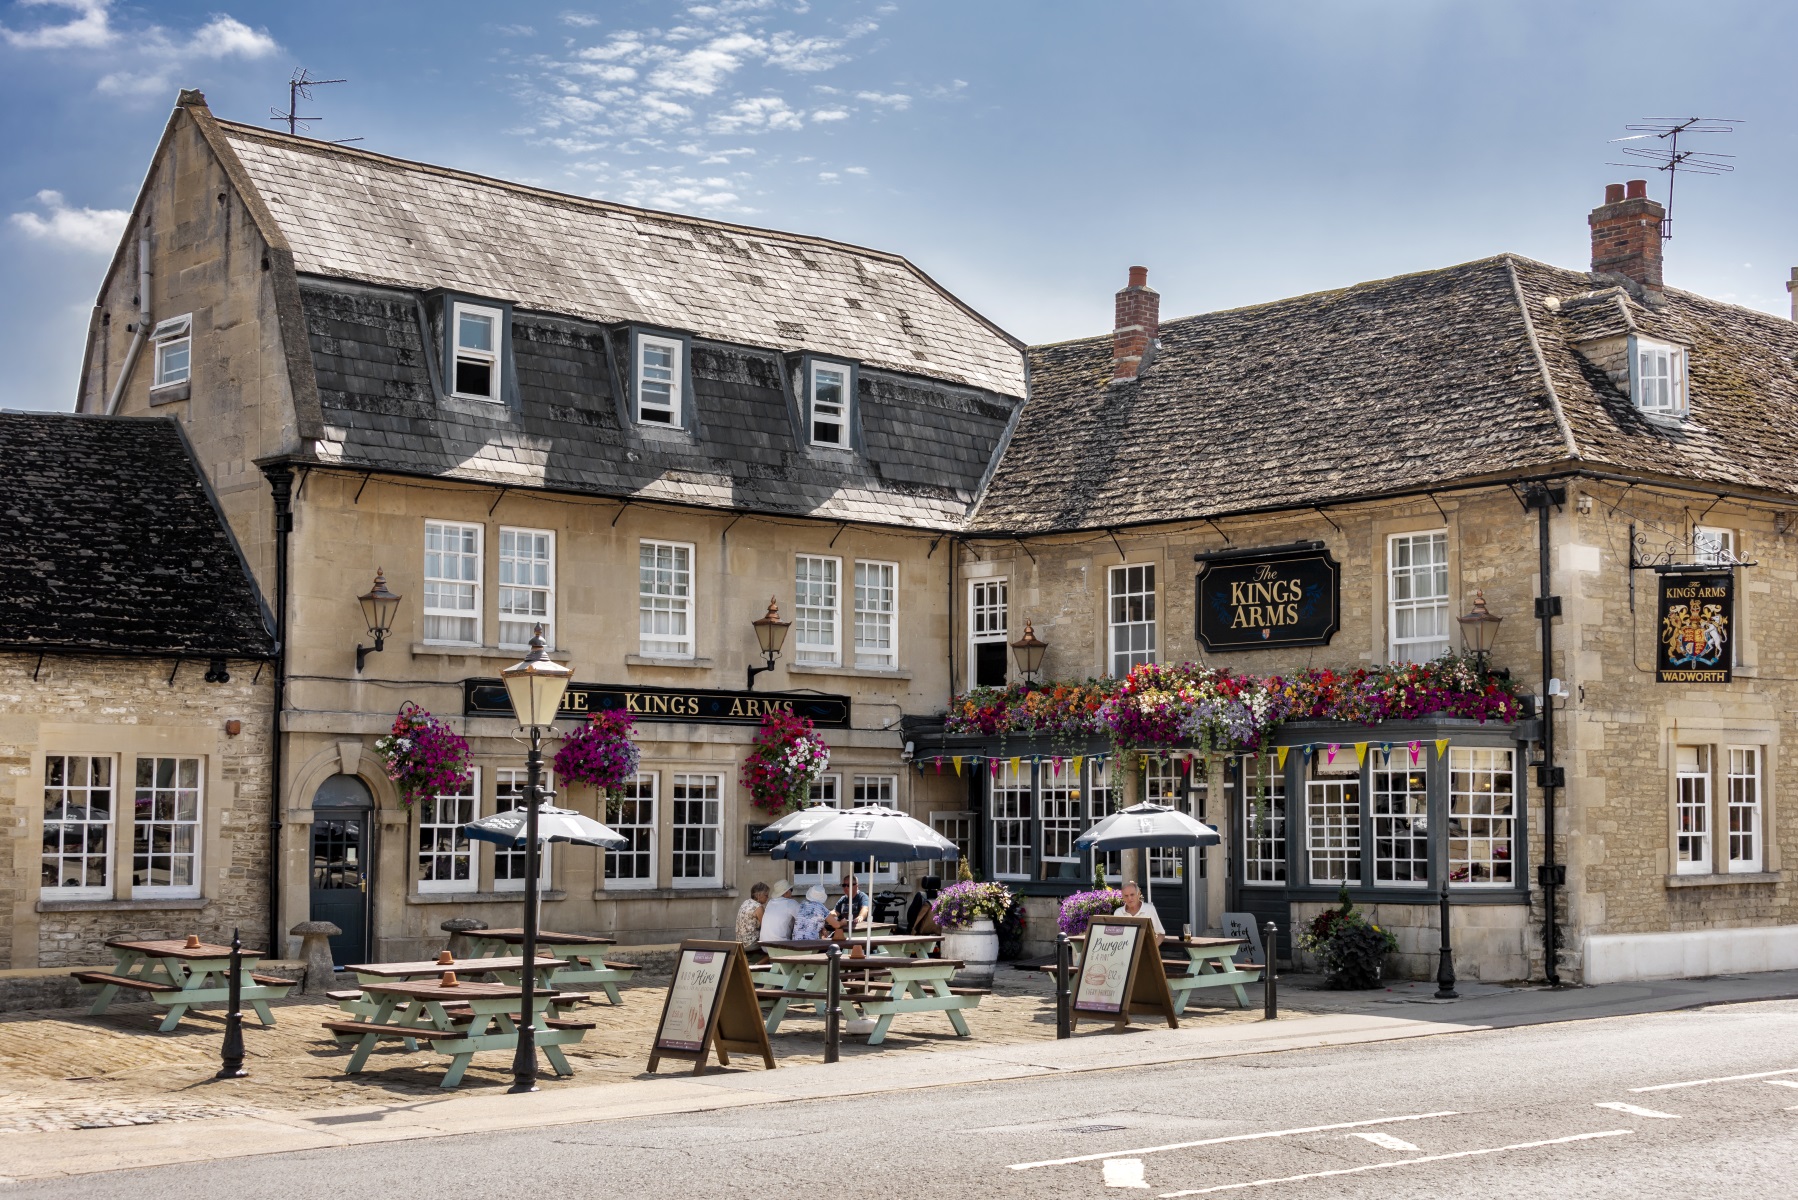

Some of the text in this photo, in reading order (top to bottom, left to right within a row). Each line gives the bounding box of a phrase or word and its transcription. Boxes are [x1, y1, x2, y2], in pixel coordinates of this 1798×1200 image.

[1252, 564, 1278, 582] The
[1230, 578, 1302, 606] KINGS
[1666, 587, 1726, 598] KINGS ARMS
[1230, 603, 1299, 629] ARMS
[1662, 672, 1725, 682] WADWORTH
[558, 691, 589, 711] HE
[624, 693, 699, 715] KINGS
[1092, 938, 1129, 956] Burger
[691, 969, 715, 986] Hire
